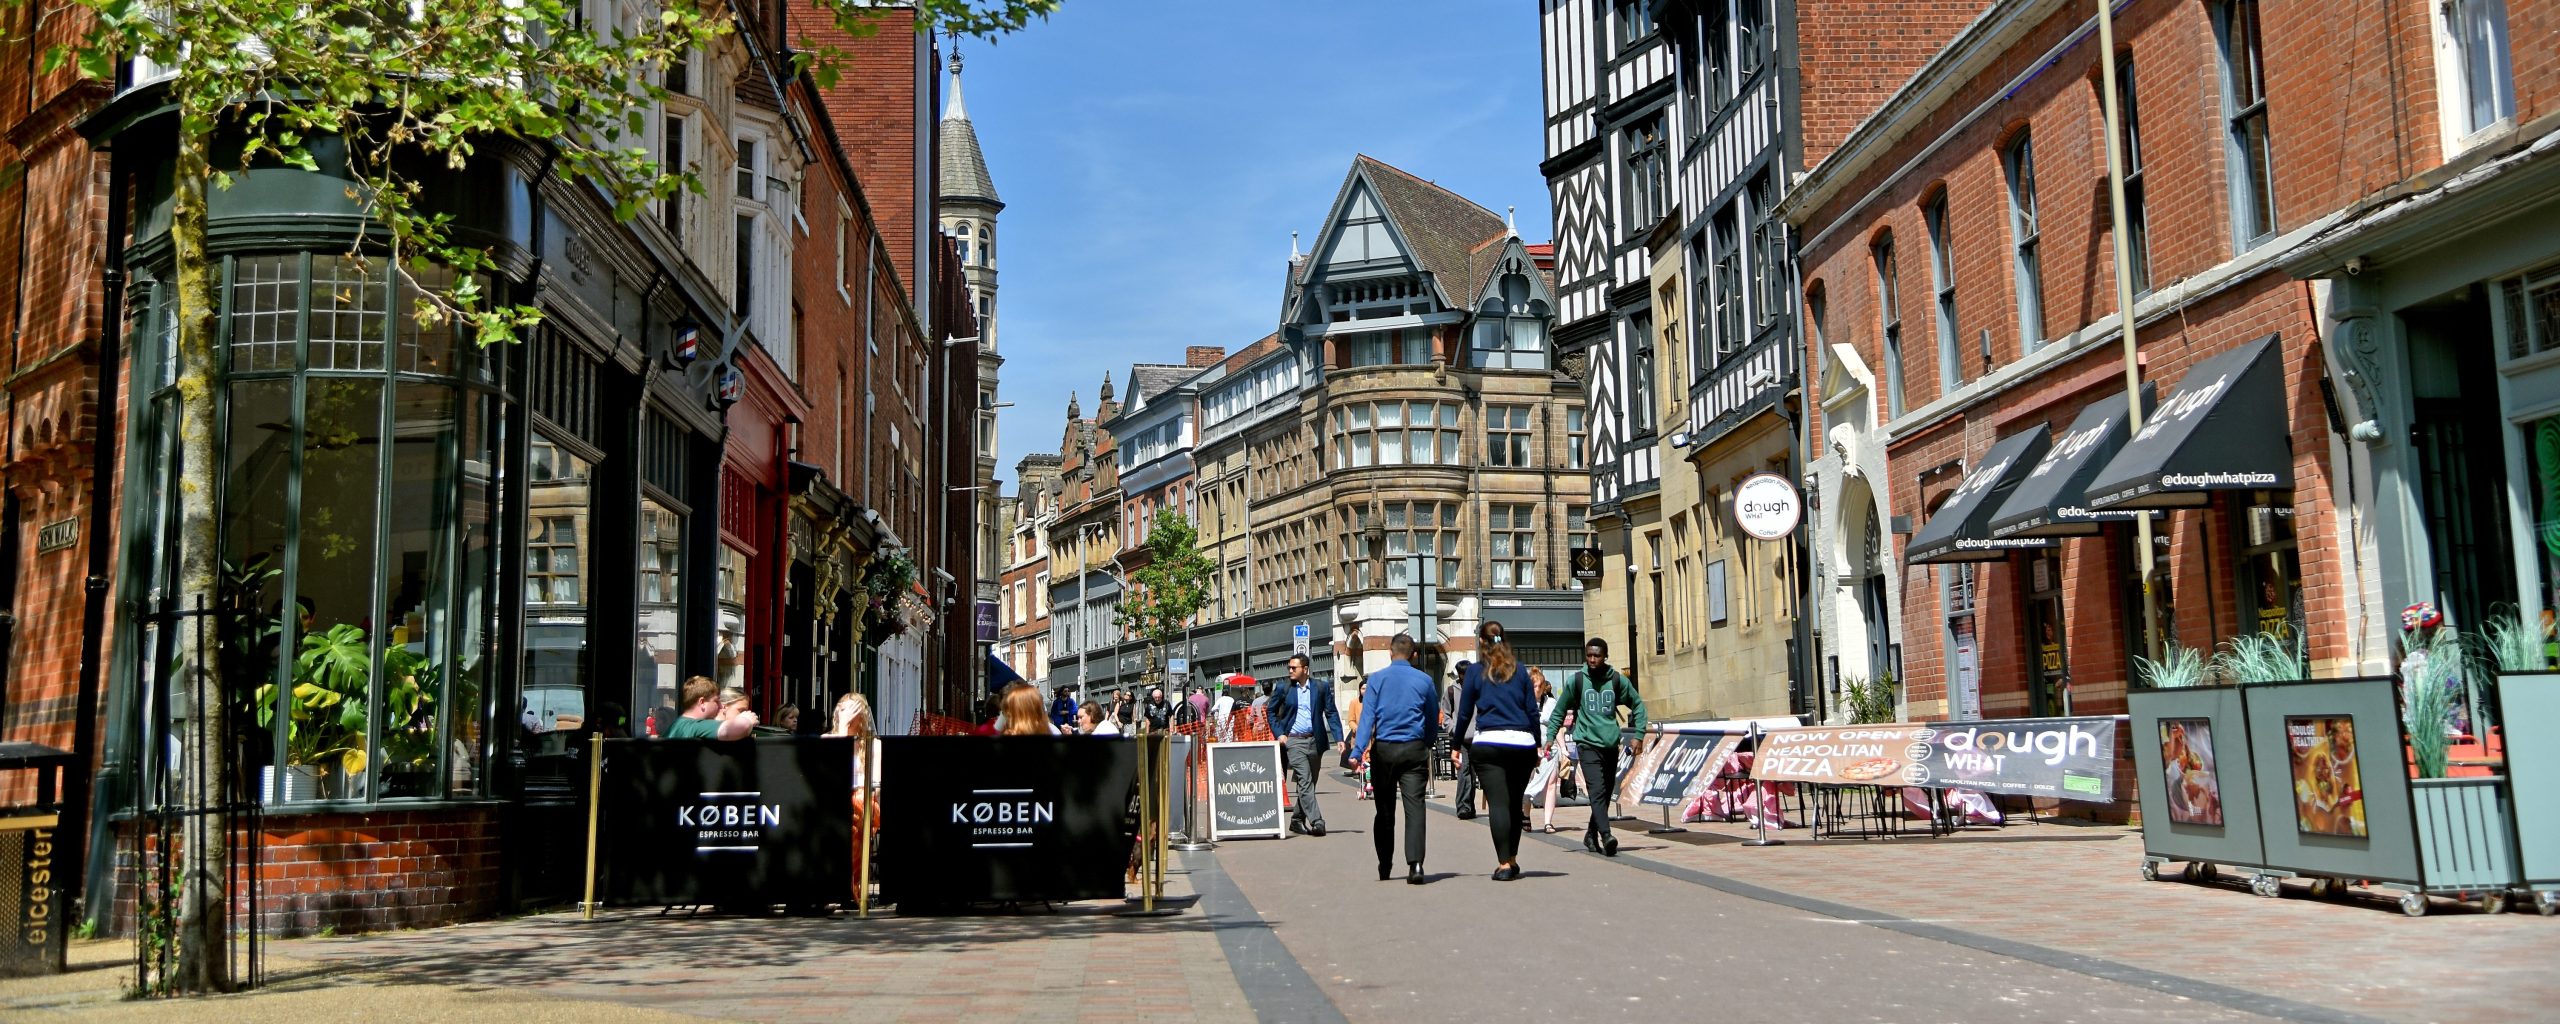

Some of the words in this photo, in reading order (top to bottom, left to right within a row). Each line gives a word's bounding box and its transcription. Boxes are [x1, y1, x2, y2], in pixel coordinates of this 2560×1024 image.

[1745, 478, 1776, 490] Neapolitan
[1776, 480, 1789, 491] Pizza
[2162, 471, 2277, 487] @doughwhatpizza
[1744, 499, 1790, 515] dough
[2042, 652, 2061, 671] PIZZA
[1772, 732, 1832, 745] NOW
[1838, 730, 1903, 741] OPEN
[1943, 724, 2097, 765] dough
[1766, 744, 1884, 757] NEAPOLITAN
[1223, 763, 1239, 776] WE
[1240, 761, 1266, 775] BREW
[1663, 739, 1711, 783] dough
[1761, 757, 1833, 777] PIZZA
[1943, 753, 2007, 775] WHAT
[1217, 781, 1274, 796] MONMOUTH
[1940, 778, 1977, 786] NEAPOLITAN
[1236, 795, 1256, 803] COFFEE
[679, 804, 780, 826] KØBEN
[952, 801, 1054, 823] KØBEN
[1236, 816, 1254, 825] about
[699, 830, 739, 838] ESPRESSO
[973, 827, 1014, 835] ESPRESSO
